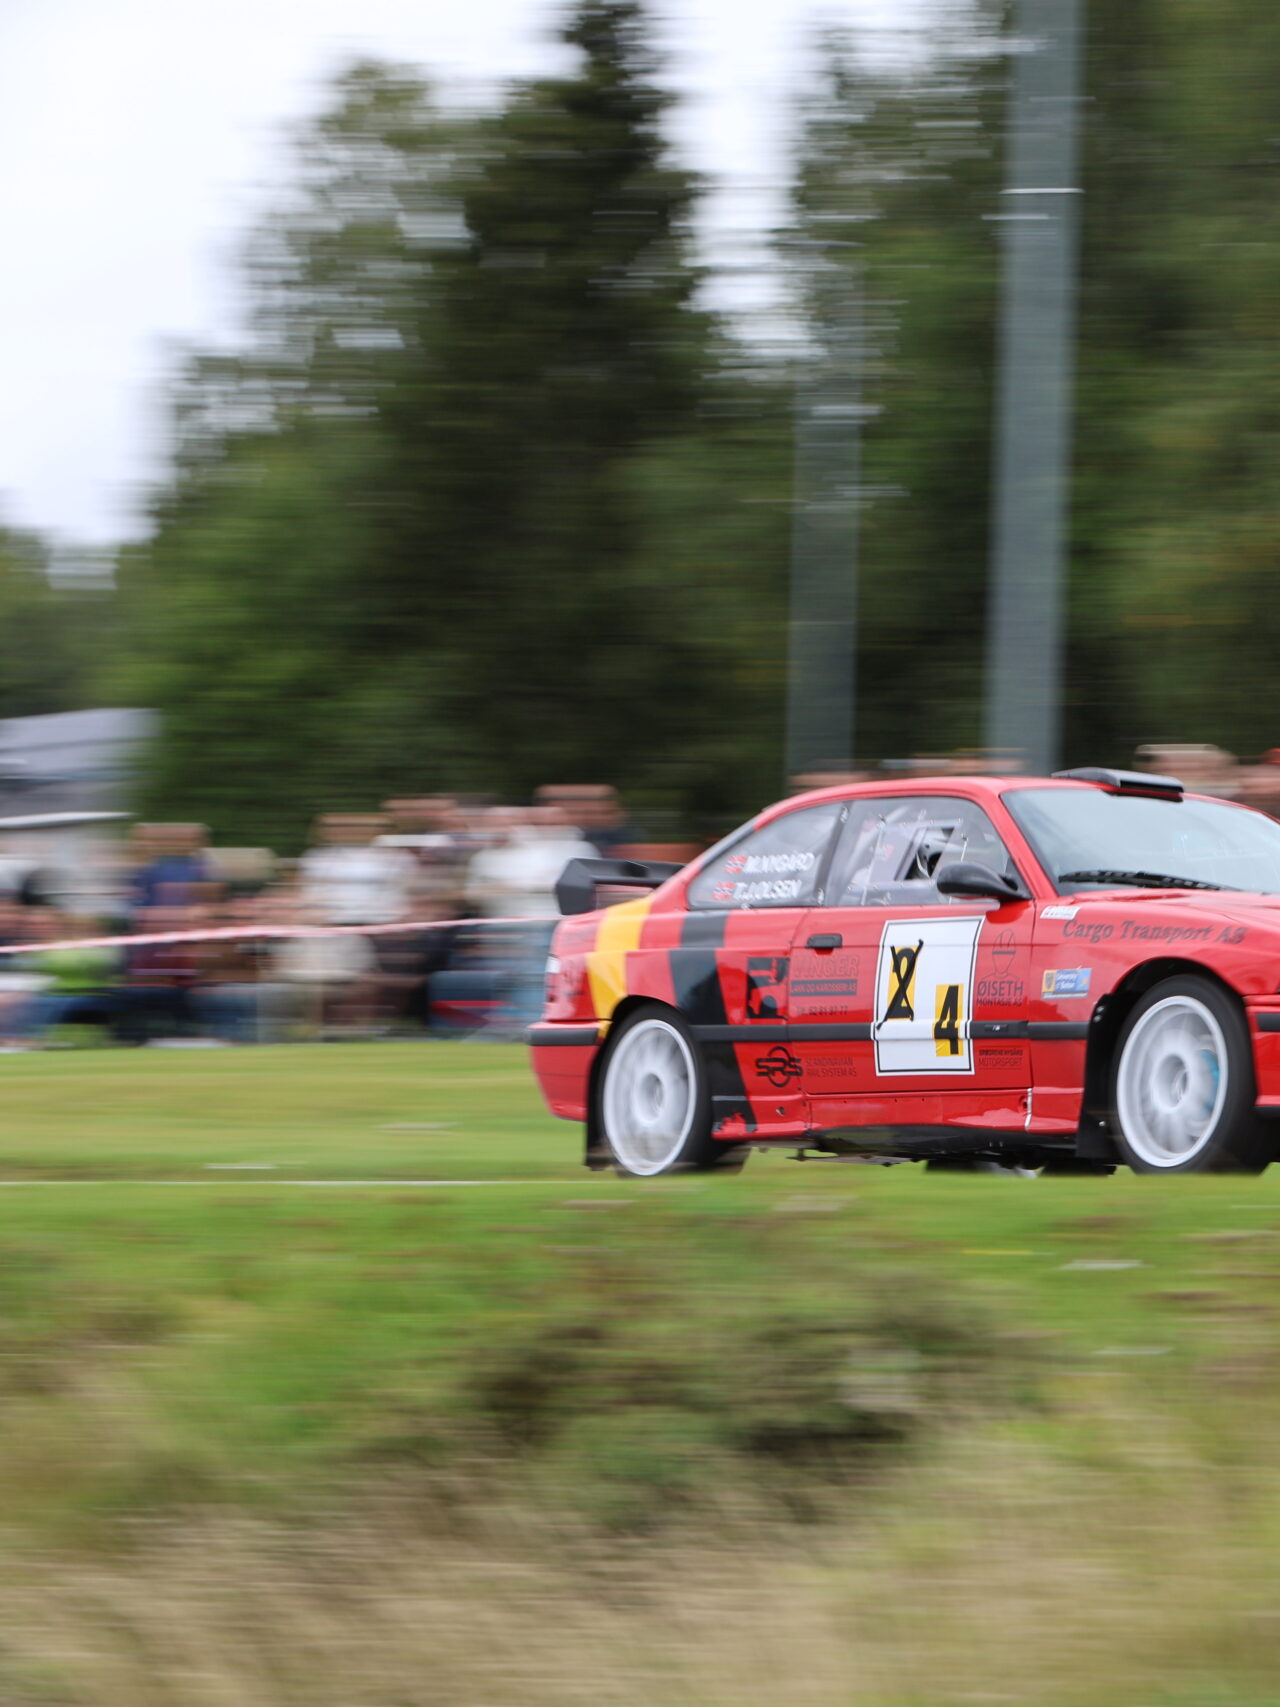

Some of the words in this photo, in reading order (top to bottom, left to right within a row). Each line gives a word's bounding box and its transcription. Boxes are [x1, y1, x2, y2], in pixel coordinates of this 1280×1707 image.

[1063, 919, 1114, 943] Cargo
[1121, 920, 1213, 943] Transport
[1215, 926, 1248, 943] AS
[793, 954, 859, 977] VINGER
[976, 981, 1024, 997] ØISETH
[934, 985, 959, 1055] 4
[755, 1057, 804, 1077] SRS
